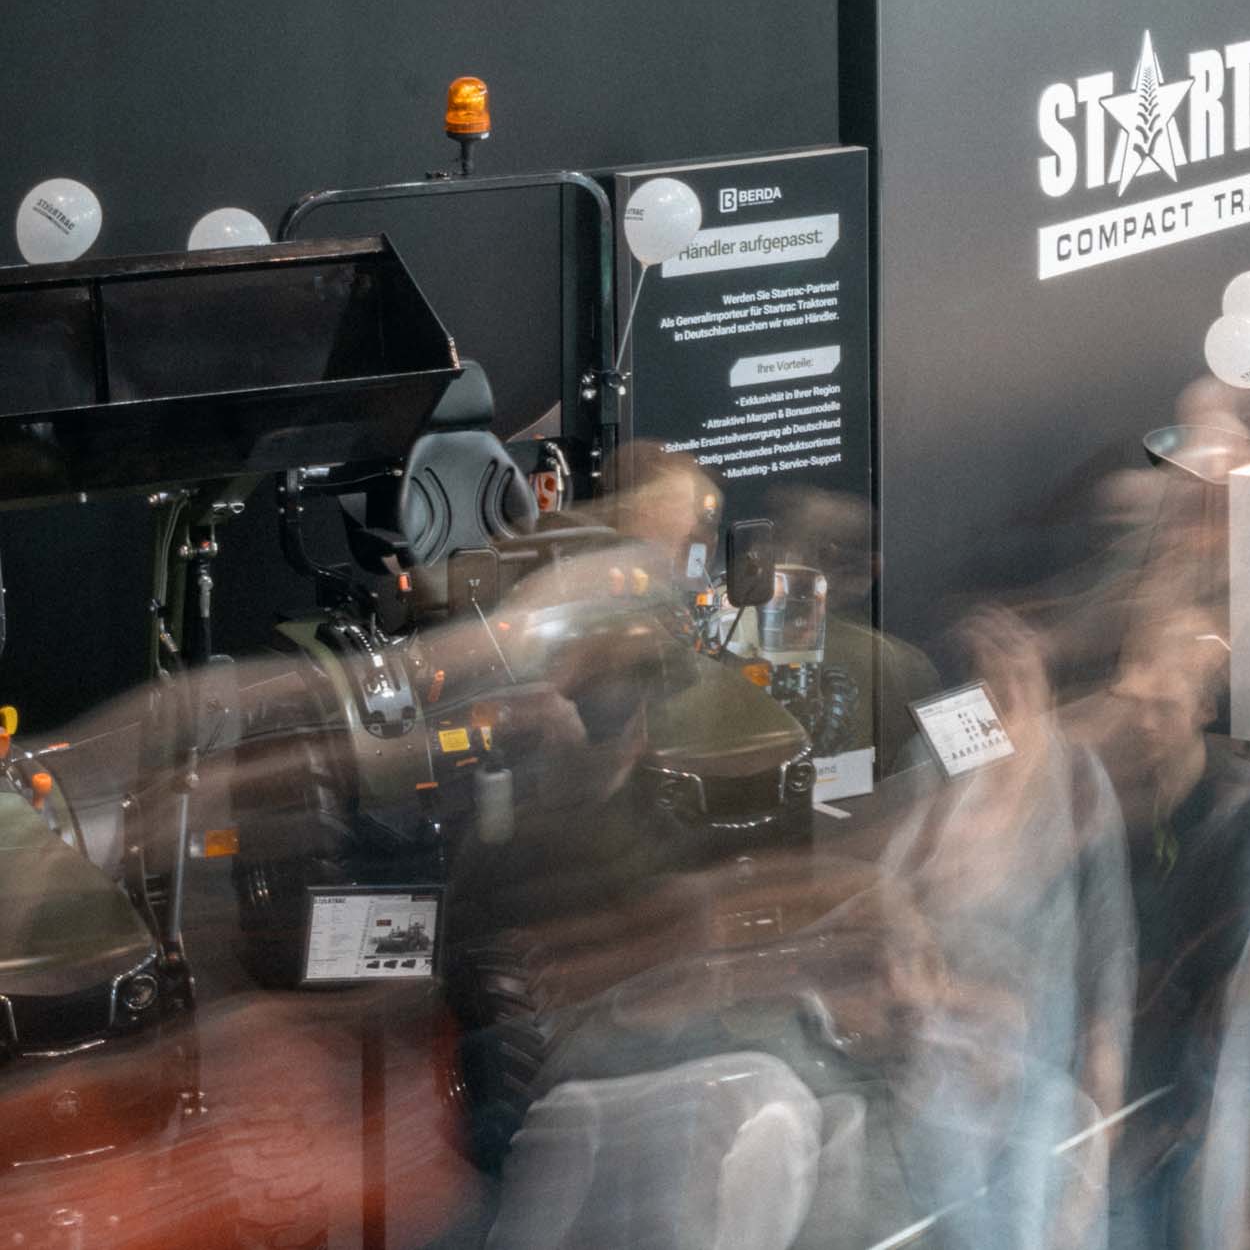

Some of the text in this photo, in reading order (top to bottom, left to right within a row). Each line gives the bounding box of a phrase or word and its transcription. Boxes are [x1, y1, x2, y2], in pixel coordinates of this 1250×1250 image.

[738, 186, 782, 203] BERDA
[739, 228, 824, 255] aufgepasst:
[1056, 201, 1194, 262] COMPACT
[722, 280, 840, 306] Werden Sie Startrac-Partner!
[659, 296, 838, 330] Als Generalimporteur für Startrac Traktoren
[674, 310, 840, 342] in Deutschland suchen wir neue Händler.
[757, 357, 814, 375] Ihre Vorteile:
[740, 384, 841, 408] Exklusivität in Ihrer Region
[707, 401, 841, 430] Attraktive Margen & Bonusmodelle
[665, 417, 841, 454] Schnelle Ersatzteilversorgung ab Deutschland
[699, 435, 842, 465] Stetig wachsendes Produktsortiment
[727, 452, 842, 479] Marketing- & Service-Support
